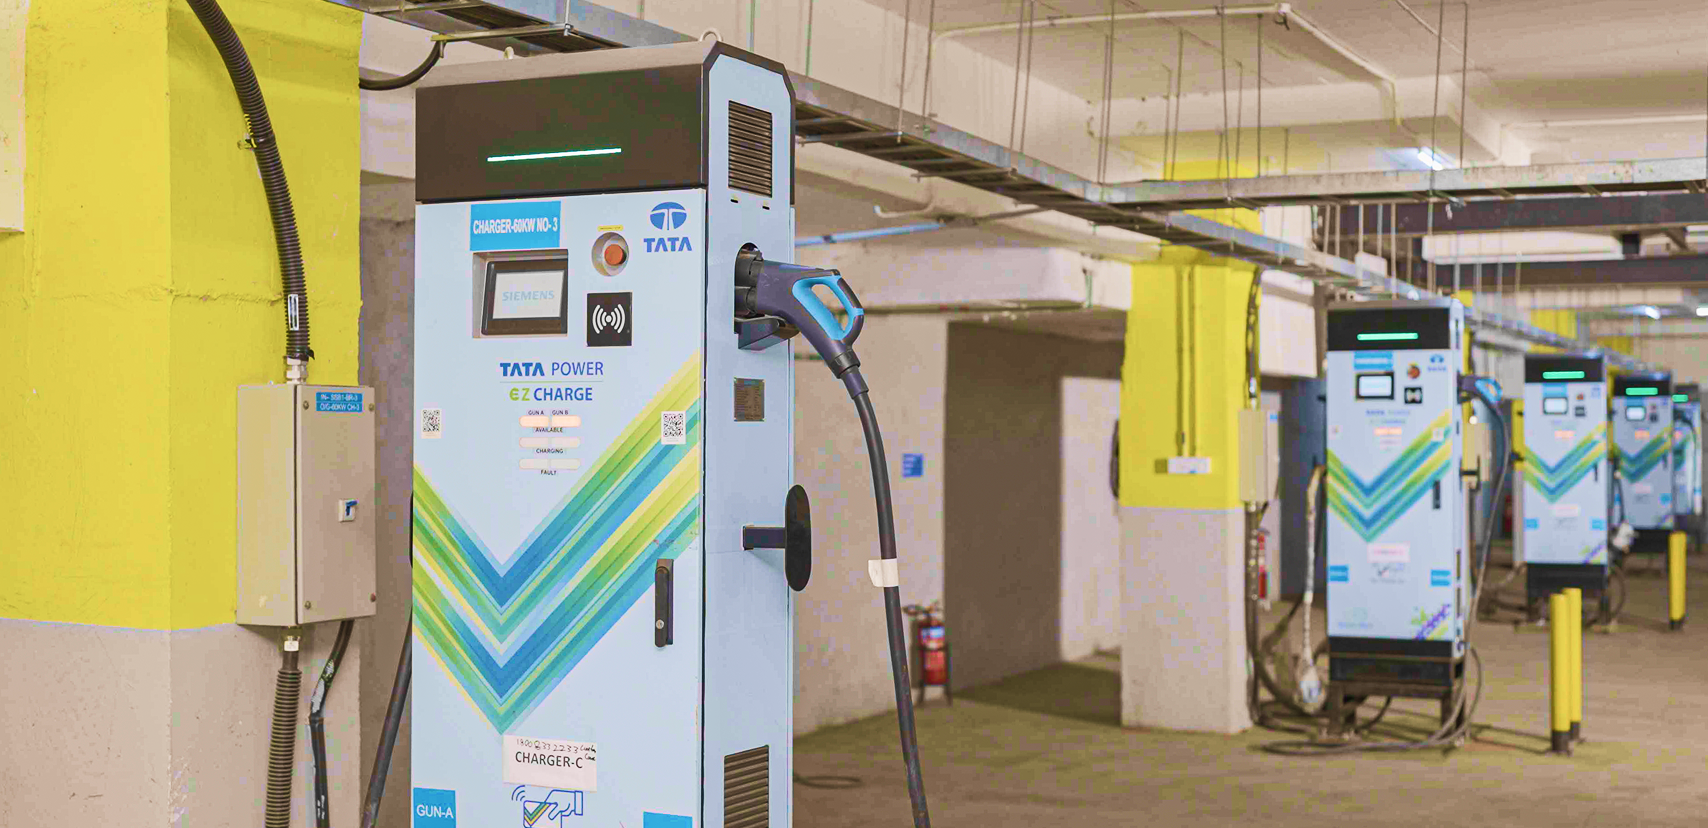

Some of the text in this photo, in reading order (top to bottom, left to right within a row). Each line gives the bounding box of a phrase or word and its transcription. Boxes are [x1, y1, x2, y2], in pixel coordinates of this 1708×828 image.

[473, 218, 536, 234] CHARGER-60KW
[643, 236, 693, 253] TATA
[502, 290, 554, 301] SIEMENS
[500, 361, 604, 376] TATA POWER
[509, 387, 593, 401] EZ CHARGE
[515, 751, 583, 768] CHARGER-C
[416, 804, 454, 819] GUN-A
